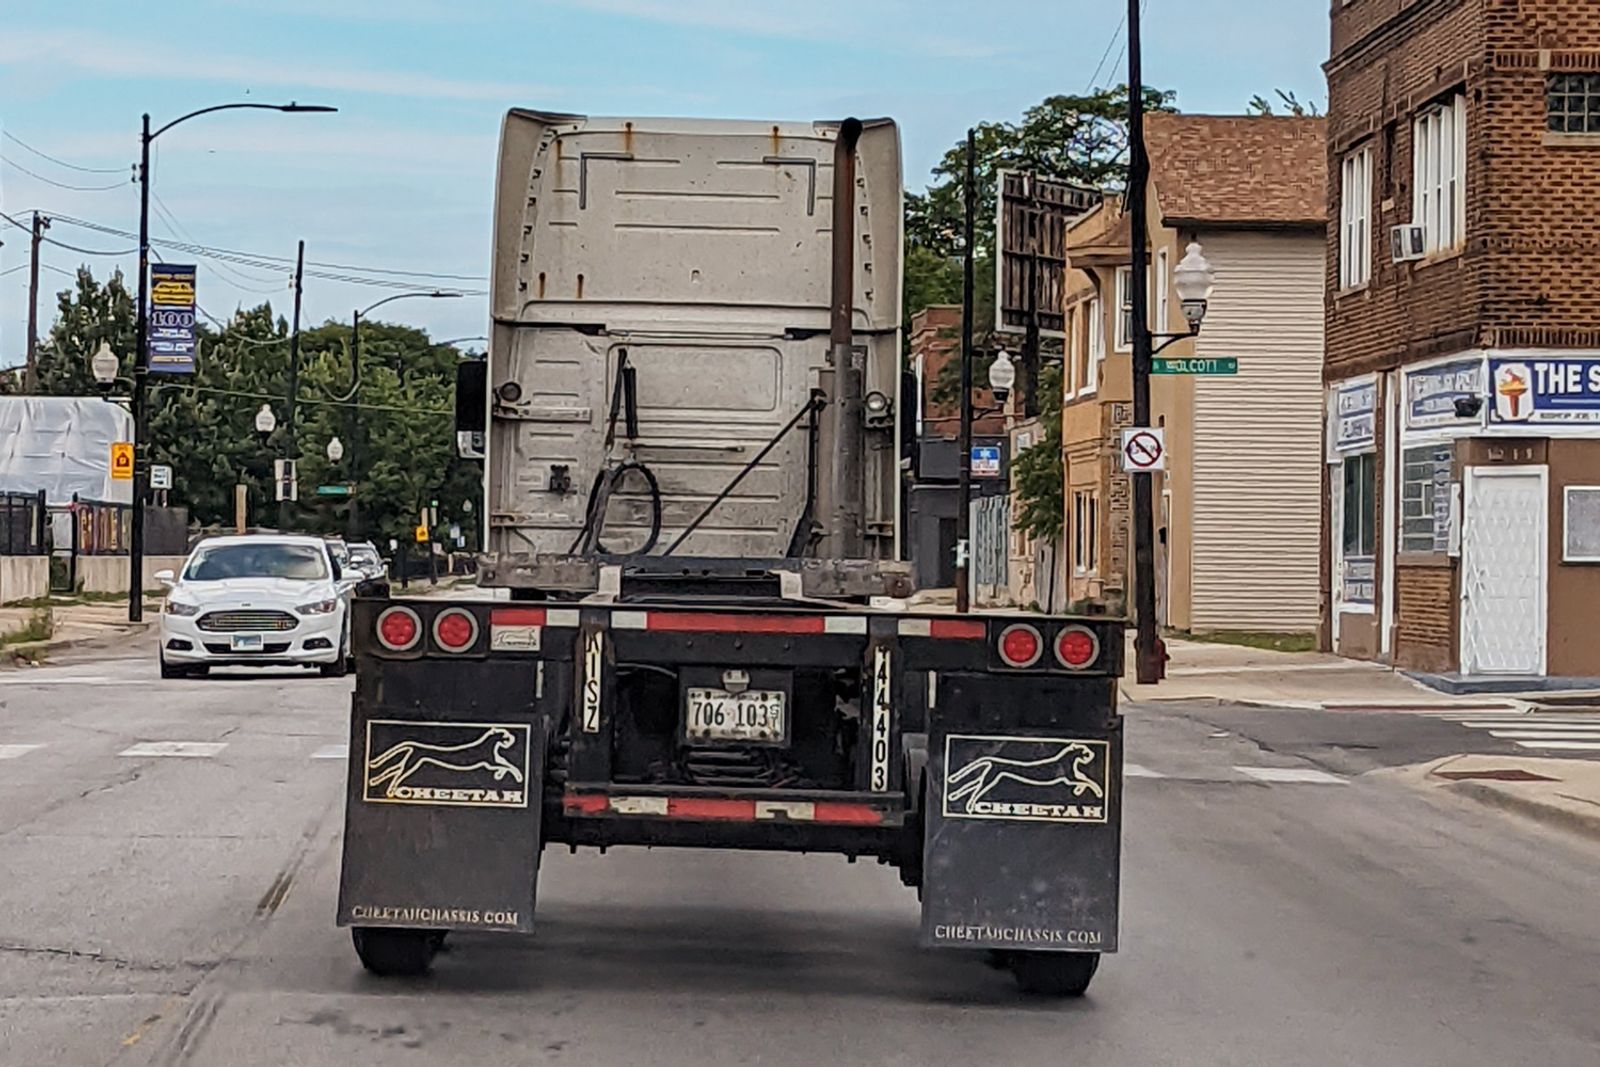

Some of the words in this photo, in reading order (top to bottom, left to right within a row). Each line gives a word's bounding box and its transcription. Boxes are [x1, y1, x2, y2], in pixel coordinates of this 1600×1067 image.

[1534, 362, 1583, 394] THE
[693, 702, 725, 726] 706
[735, 703, 768, 727] 103
[396, 786, 523, 803] CHEETAH
[975, 802, 1102, 818] CHEETAH
